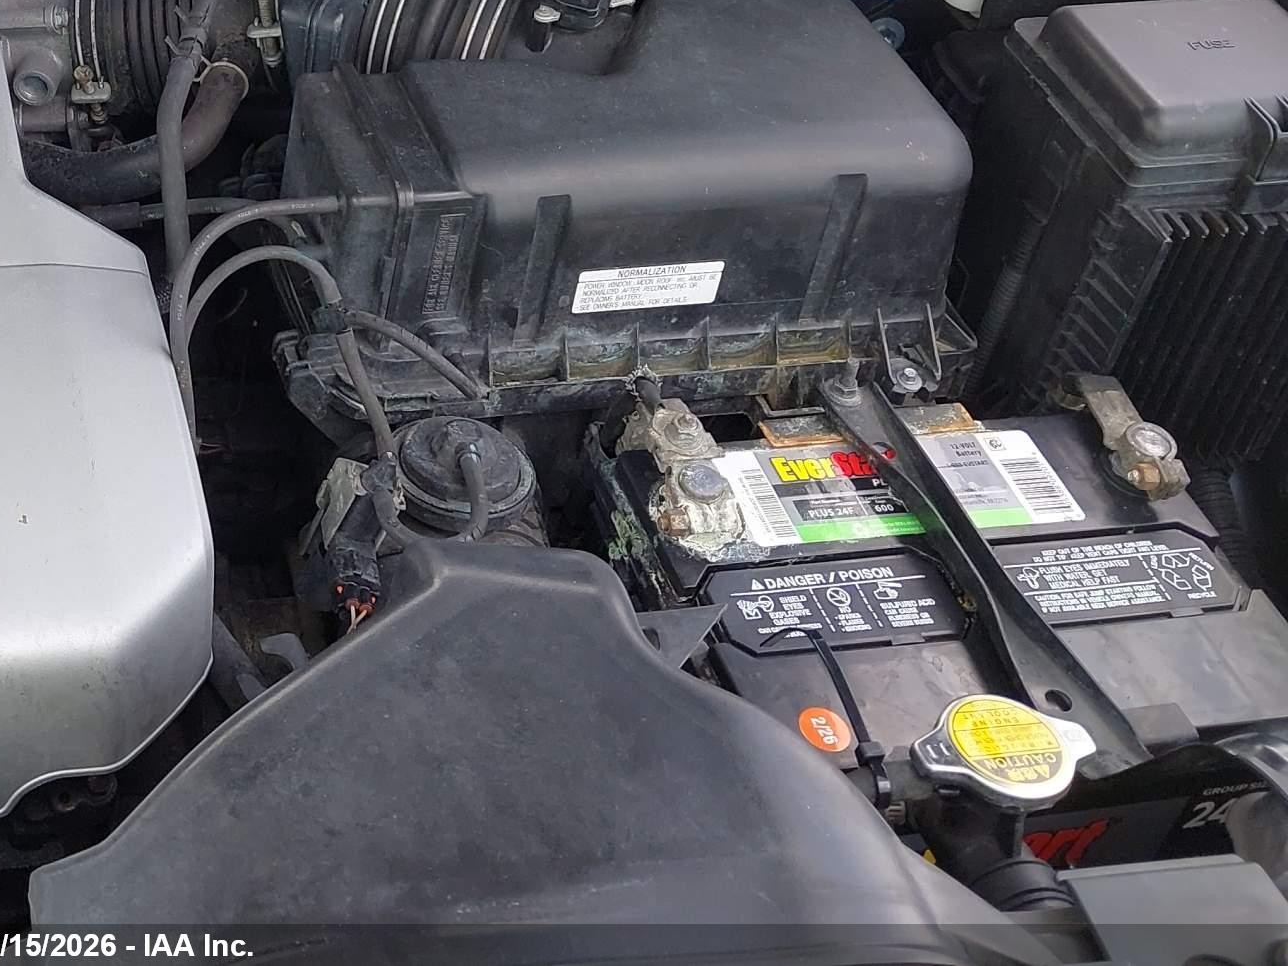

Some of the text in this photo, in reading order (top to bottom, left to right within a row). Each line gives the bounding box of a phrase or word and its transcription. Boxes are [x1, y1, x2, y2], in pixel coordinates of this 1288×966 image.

[1187, 40, 1235, 50] FUSE
[617, 265, 687, 279] NORMALIZATION
[808, 506, 854, 518] PLUS 24F
[874, 503, 894, 513] 600
[1038, 559, 1130, 575] FLUSH EYES IMMEDIATELY
[764, 573, 827, 590] DANGER
[839, 566, 894, 582] POISON
[1043, 574, 1065, 582] WITH
[1091, 569, 1108, 577] GET
[1048, 575, 1120, 590] MEDICAL HELP FAST
[779, 595, 807, 603] SHIELD
[1187, 590, 1217, 600] RECYCLE
[782, 602, 805, 610] EYES
[773, 617, 800, 626] GASES
[810, 716, 839, 745] 2/26
[983, 752, 1057, 770] CAUTION
[1202, 783, 1249, 796] GROUP
